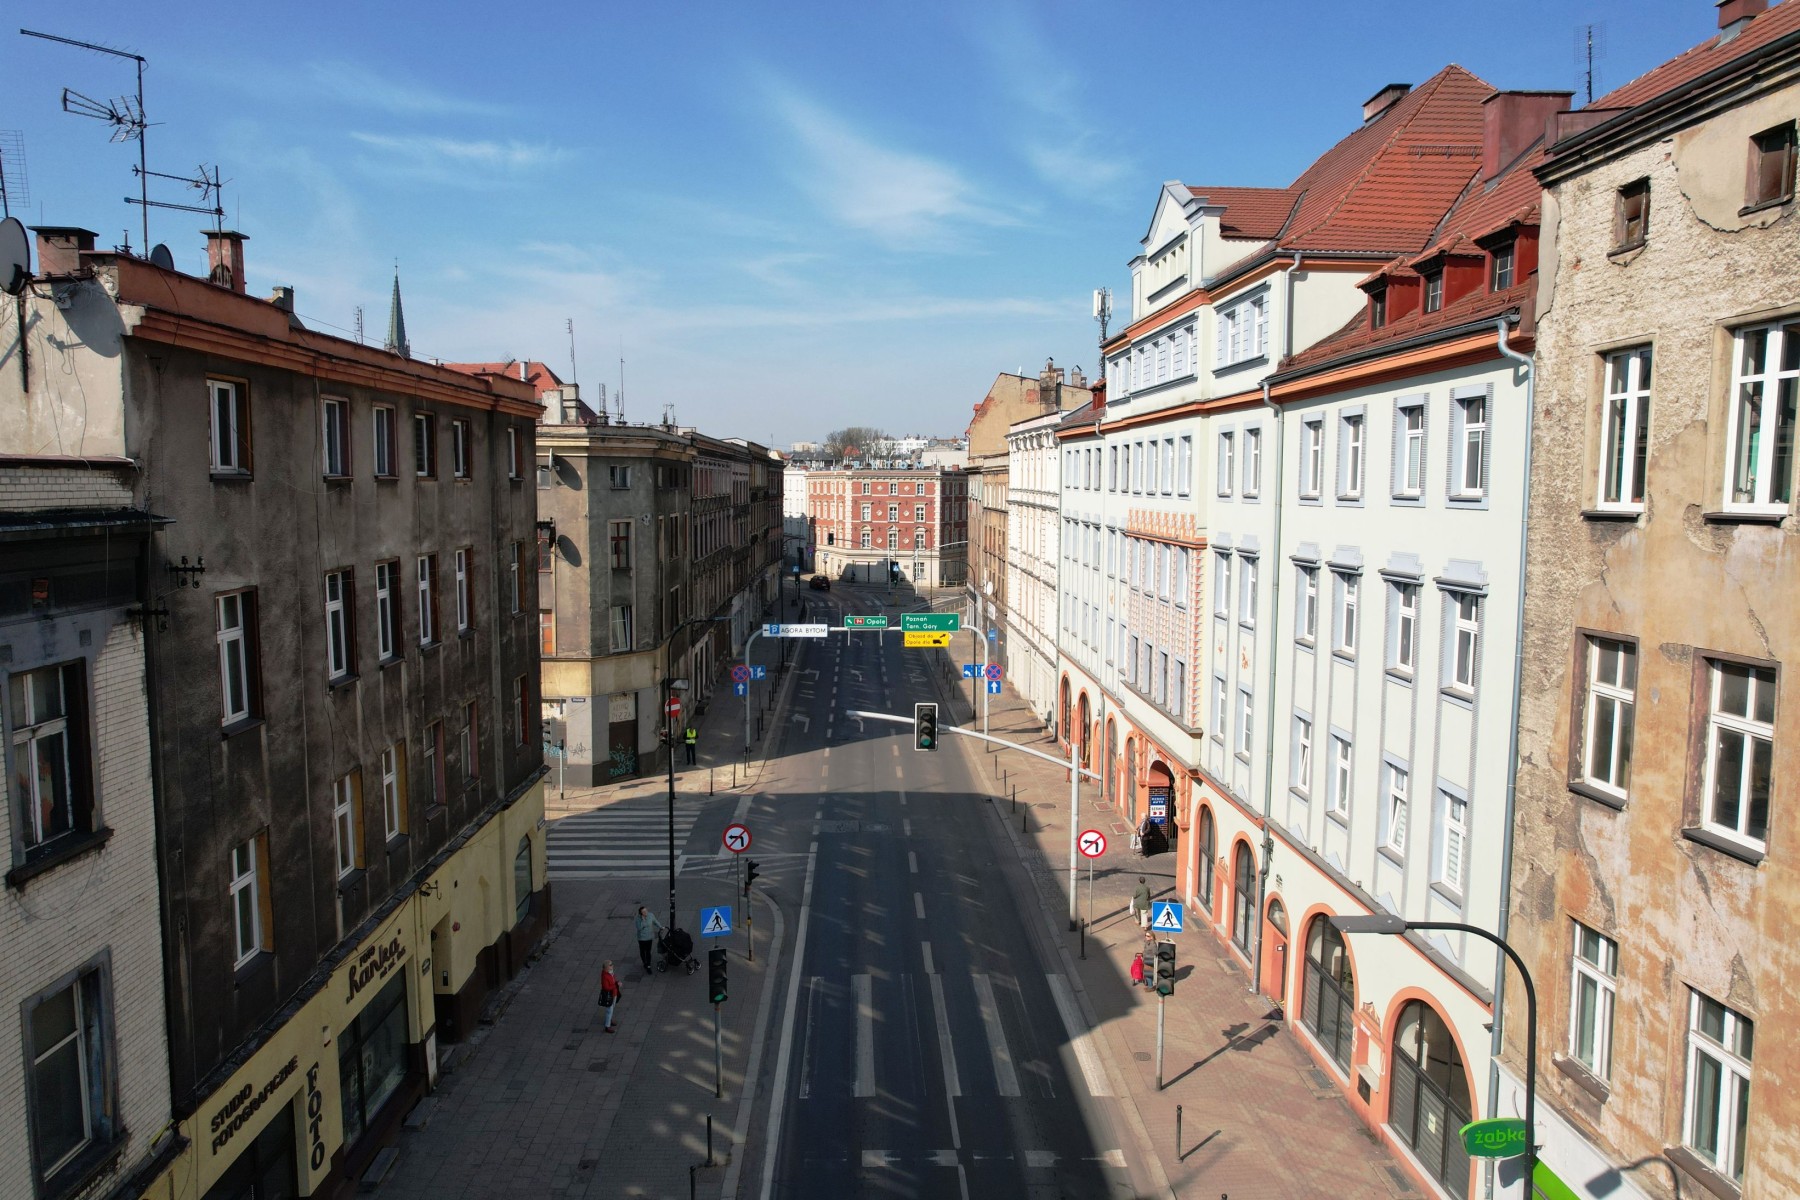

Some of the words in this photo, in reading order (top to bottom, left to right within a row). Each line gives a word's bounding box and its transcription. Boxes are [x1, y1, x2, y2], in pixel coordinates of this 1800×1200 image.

[211, 1084, 252, 1132] STUDIO
[212, 1054, 298, 1156] FOTOGRAFICZNE
[306, 1061, 324, 1170] FOTO
